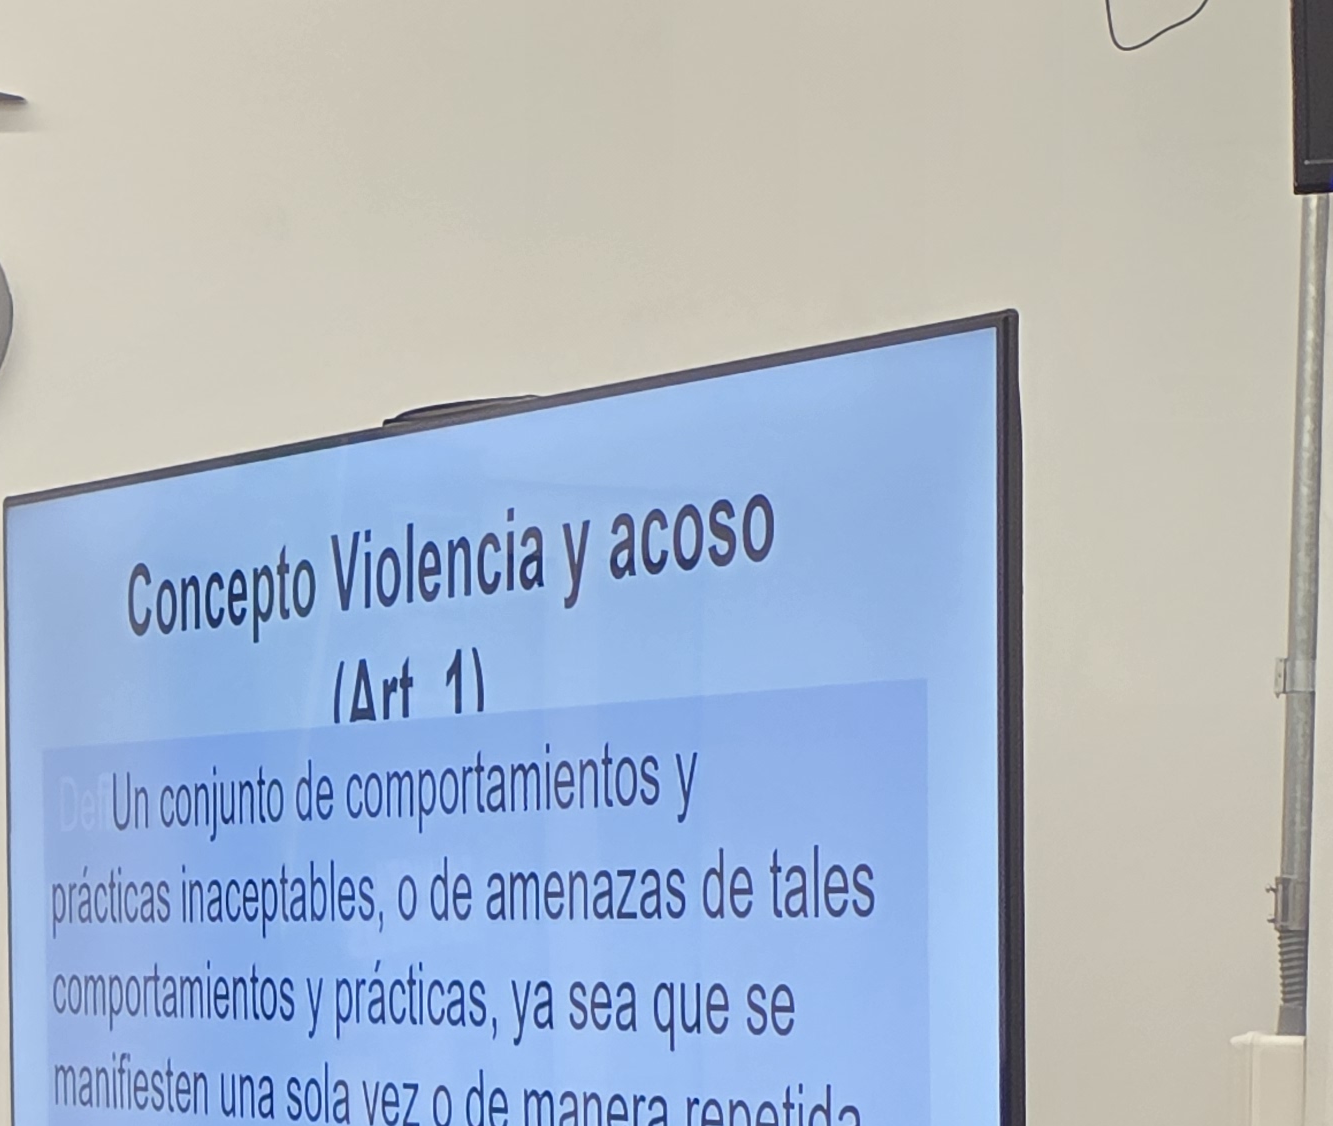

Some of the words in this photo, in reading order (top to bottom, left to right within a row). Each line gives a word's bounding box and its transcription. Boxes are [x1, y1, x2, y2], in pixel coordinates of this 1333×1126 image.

[127, 544, 317, 644] Concepto
[330, 506, 545, 612] Violencia
[561, 519, 591, 610] y
[609, 493, 775, 580] acoso
[112, 771, 149, 832] Un
[159, 764, 285, 843] conjunto
[295, 758, 334, 822] de
[346, 741, 661, 835] comportamientos
[675, 751, 699, 824] y
[51, 865, 171, 940] prácticas
[181, 858, 384, 940] inaceptables,
[397, 874, 418, 922] o
[430, 855, 473, 922] de
[485, 867, 687, 922] amenazas
[702, 846, 754, 920] de
[769, 844, 876, 919] tales
[52, 959, 295, 1032] comportamientos
[305, 977, 324, 1040] y
[335, 959, 498, 1041] prácticas,
[510, 979, 555, 1047] ya
[569, 980, 638, 1033] sea
[653, 981, 730, 1053] que
[746, 983, 796, 1037] se
[54, 1052, 209, 1116] manifiesten
[220, 1072, 275, 1120] una
[286, 1061, 351, 1126] sola
